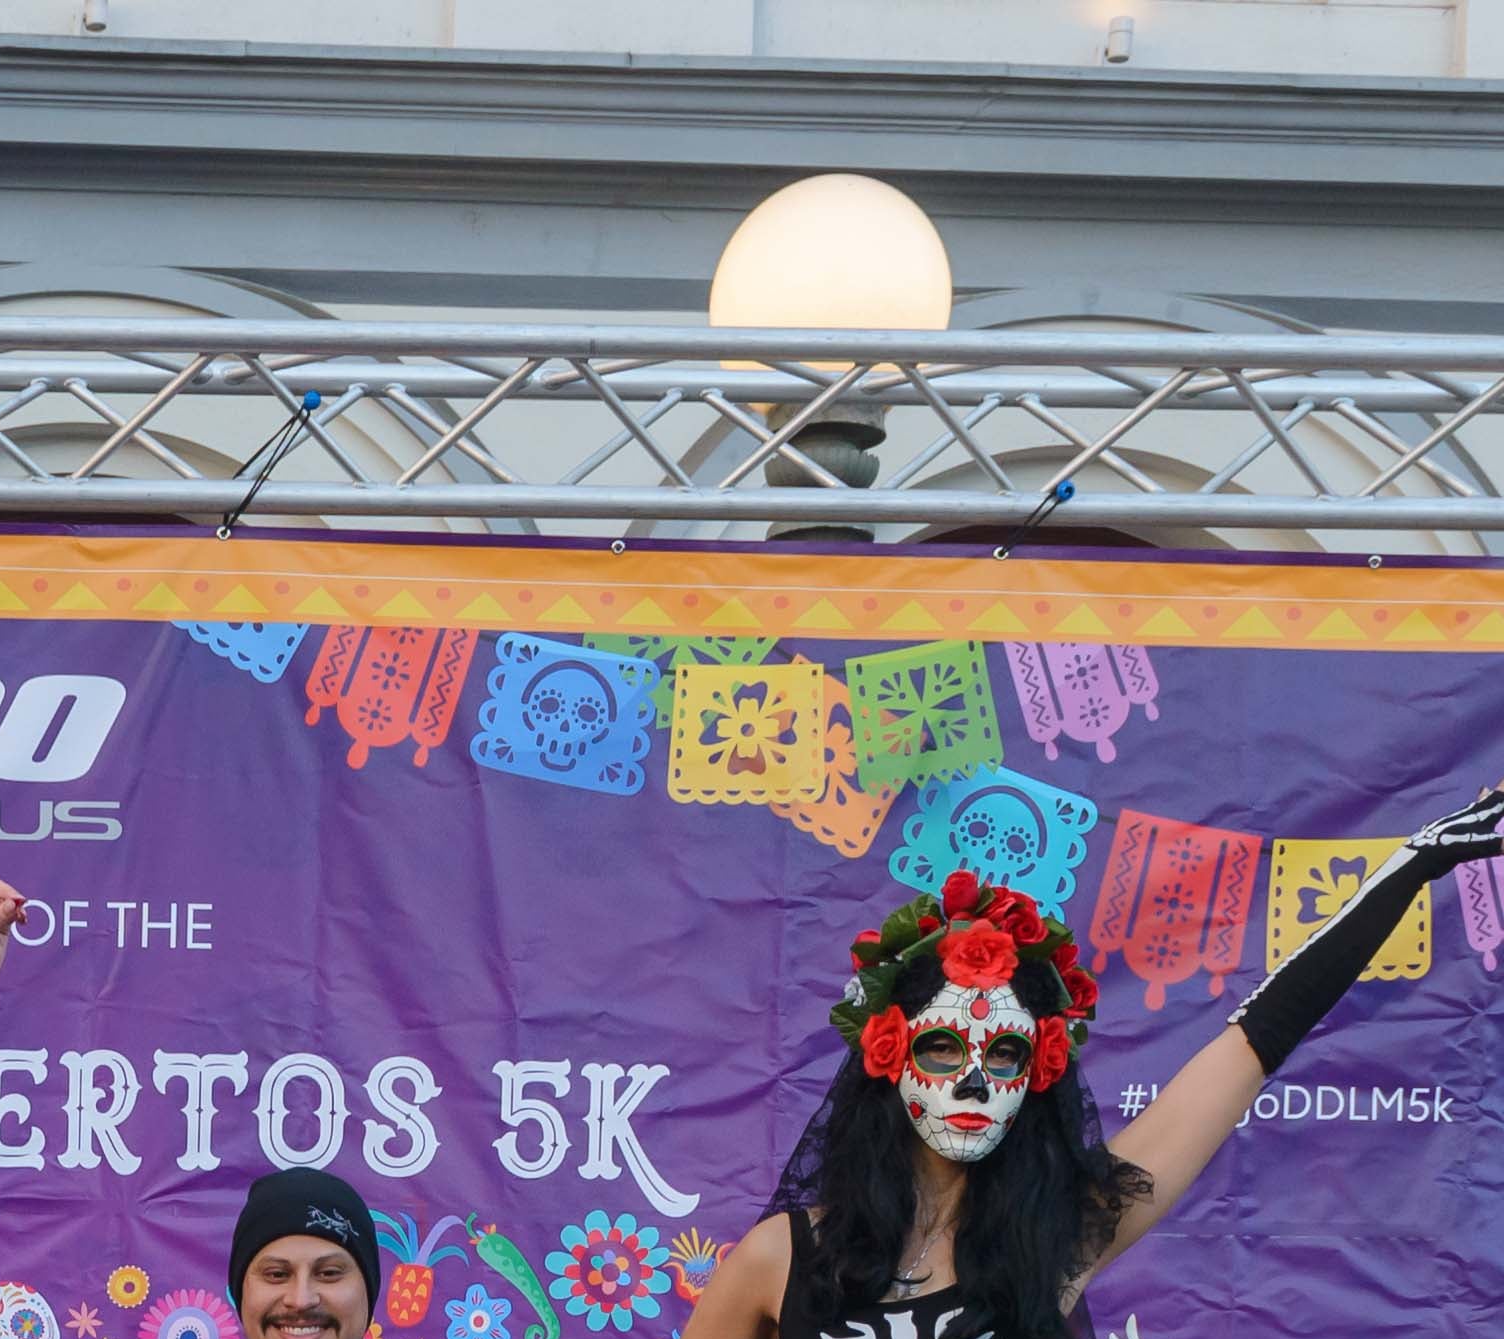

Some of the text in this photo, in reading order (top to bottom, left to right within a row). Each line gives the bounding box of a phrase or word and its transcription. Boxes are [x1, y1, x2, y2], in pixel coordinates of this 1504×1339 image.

[10, 900, 89, 947] OF
[105, 901, 214, 949] THE
[1118, 1083, 1455, 1129] #oDDLM5k
[493, 1057, 700, 1218] 5K
